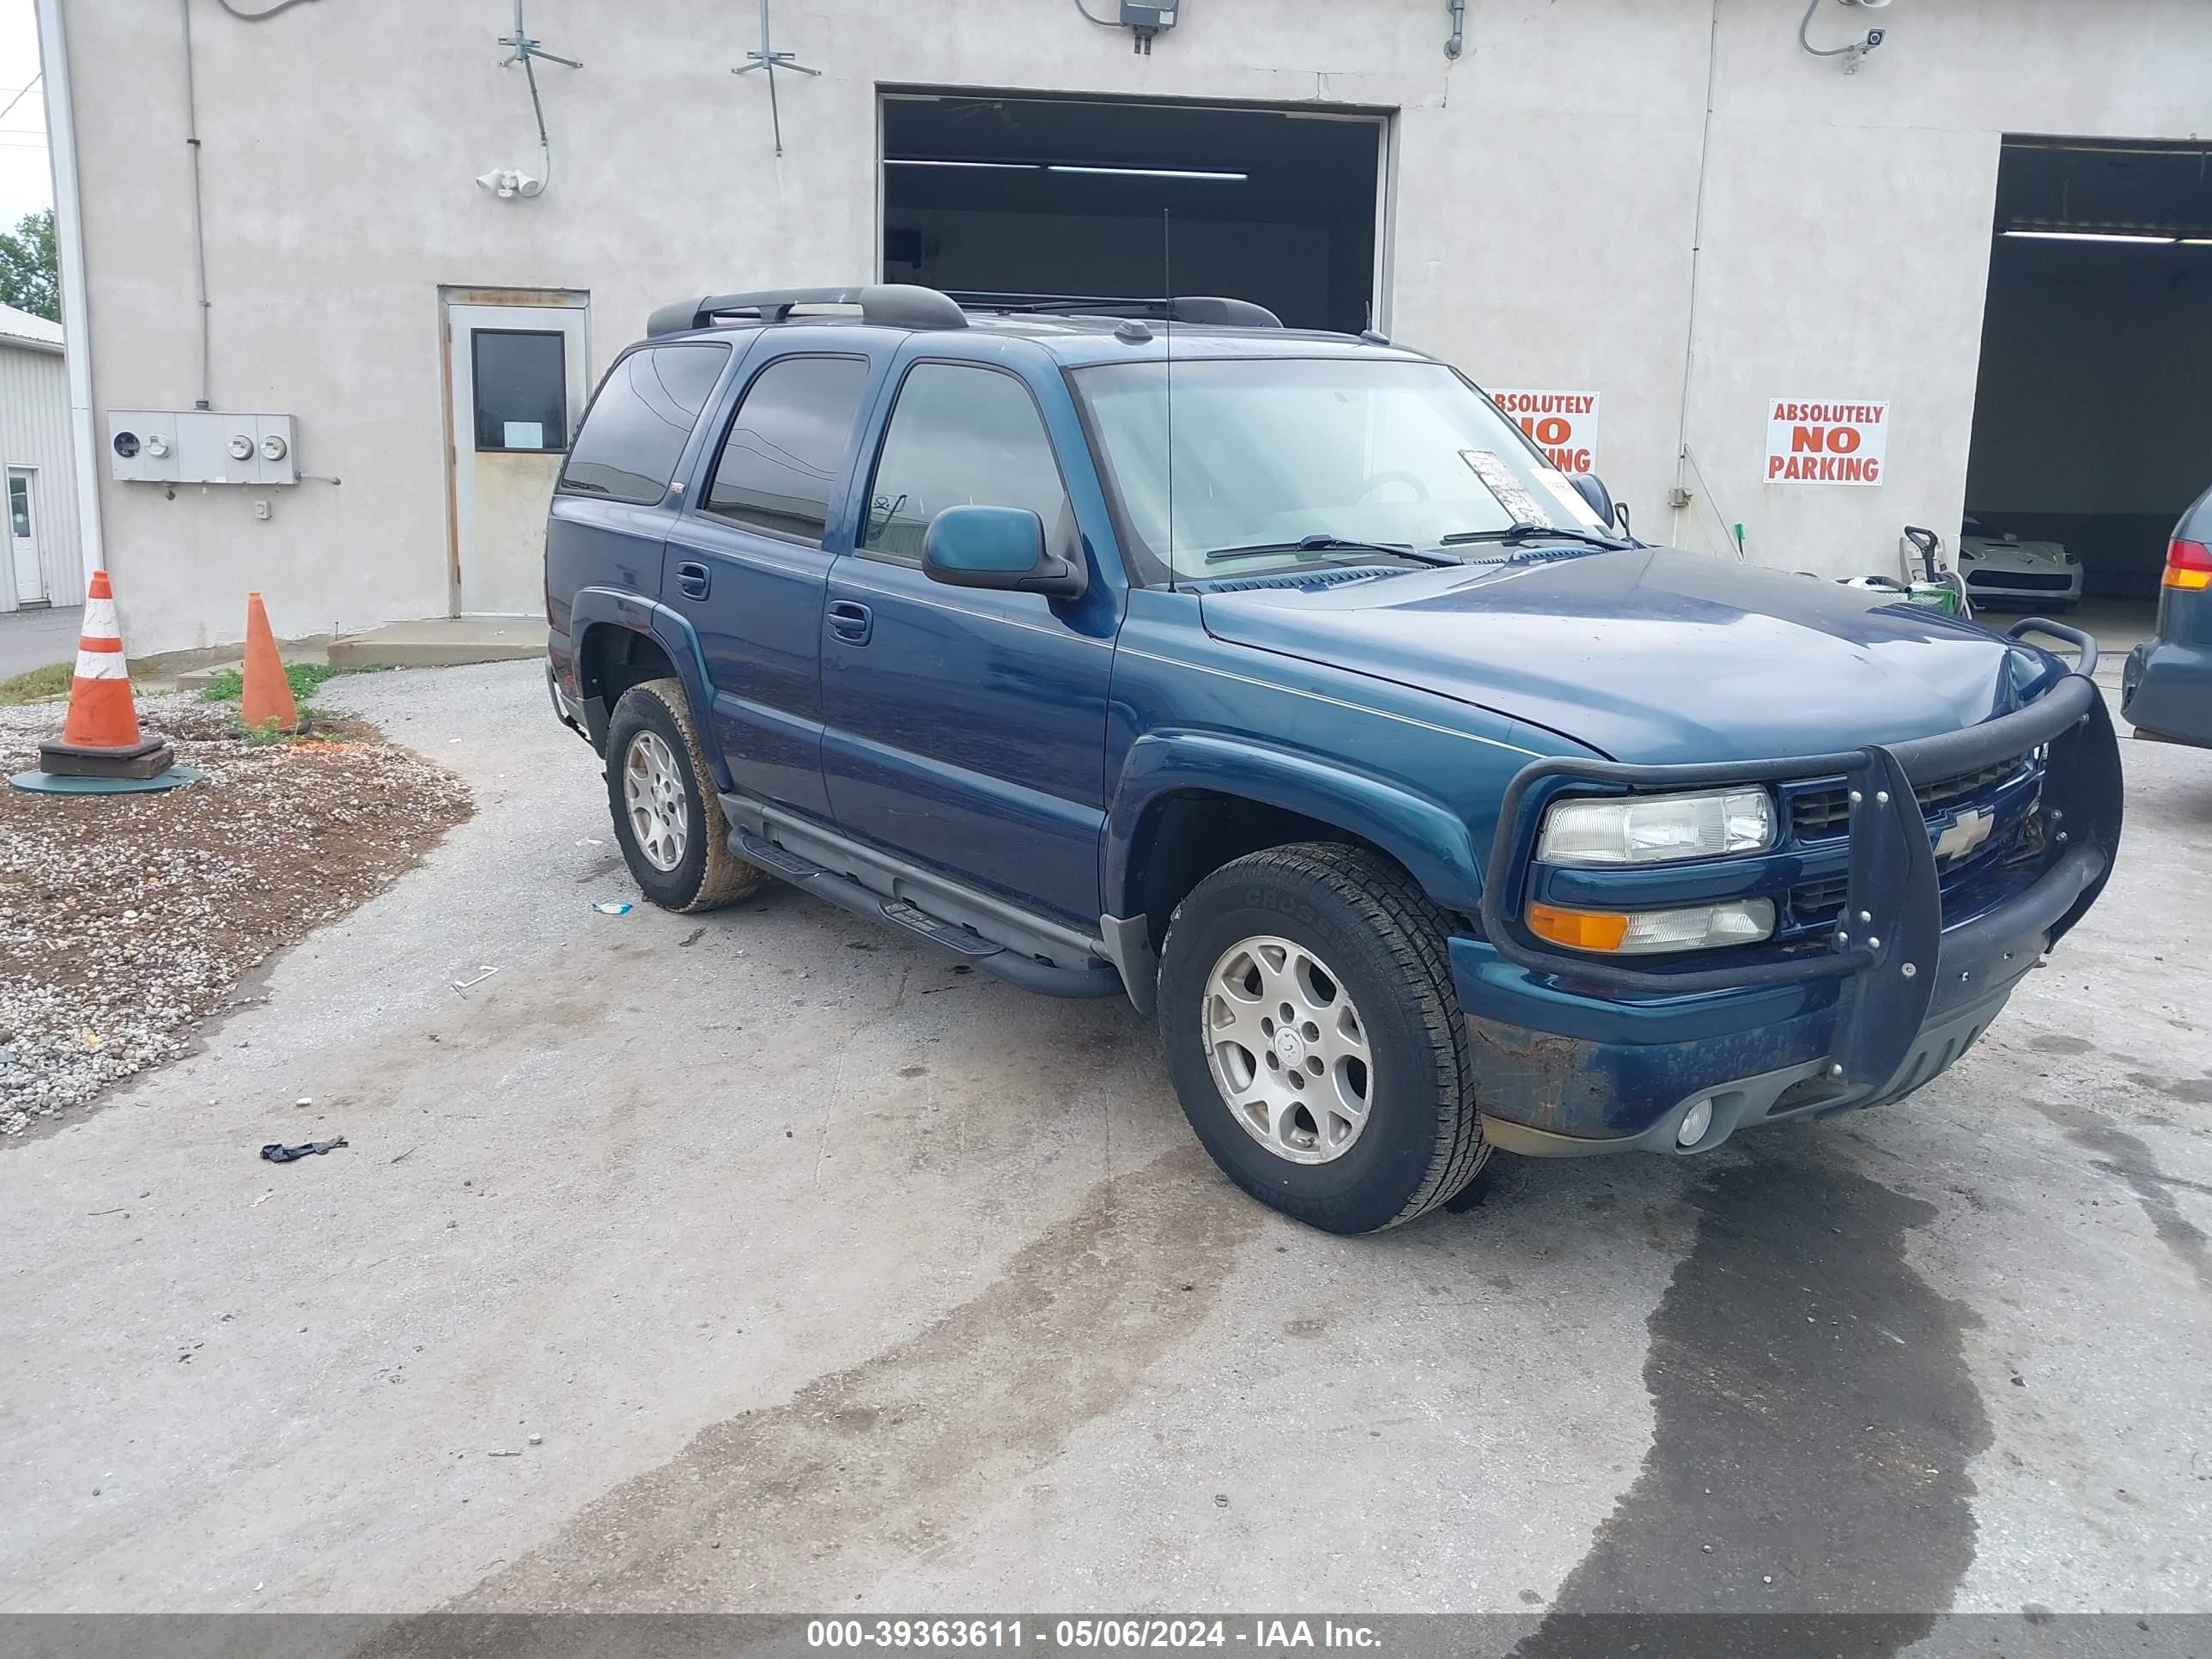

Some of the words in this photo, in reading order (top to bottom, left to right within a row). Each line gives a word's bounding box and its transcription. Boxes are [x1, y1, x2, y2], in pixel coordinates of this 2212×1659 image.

[1488, 393, 1595, 414] BSOLUTELY
[1773, 403, 1884, 423] ABSOLUTELY
[1791, 426, 1861, 454] NO
[1768, 455, 1880, 482] PARKING
